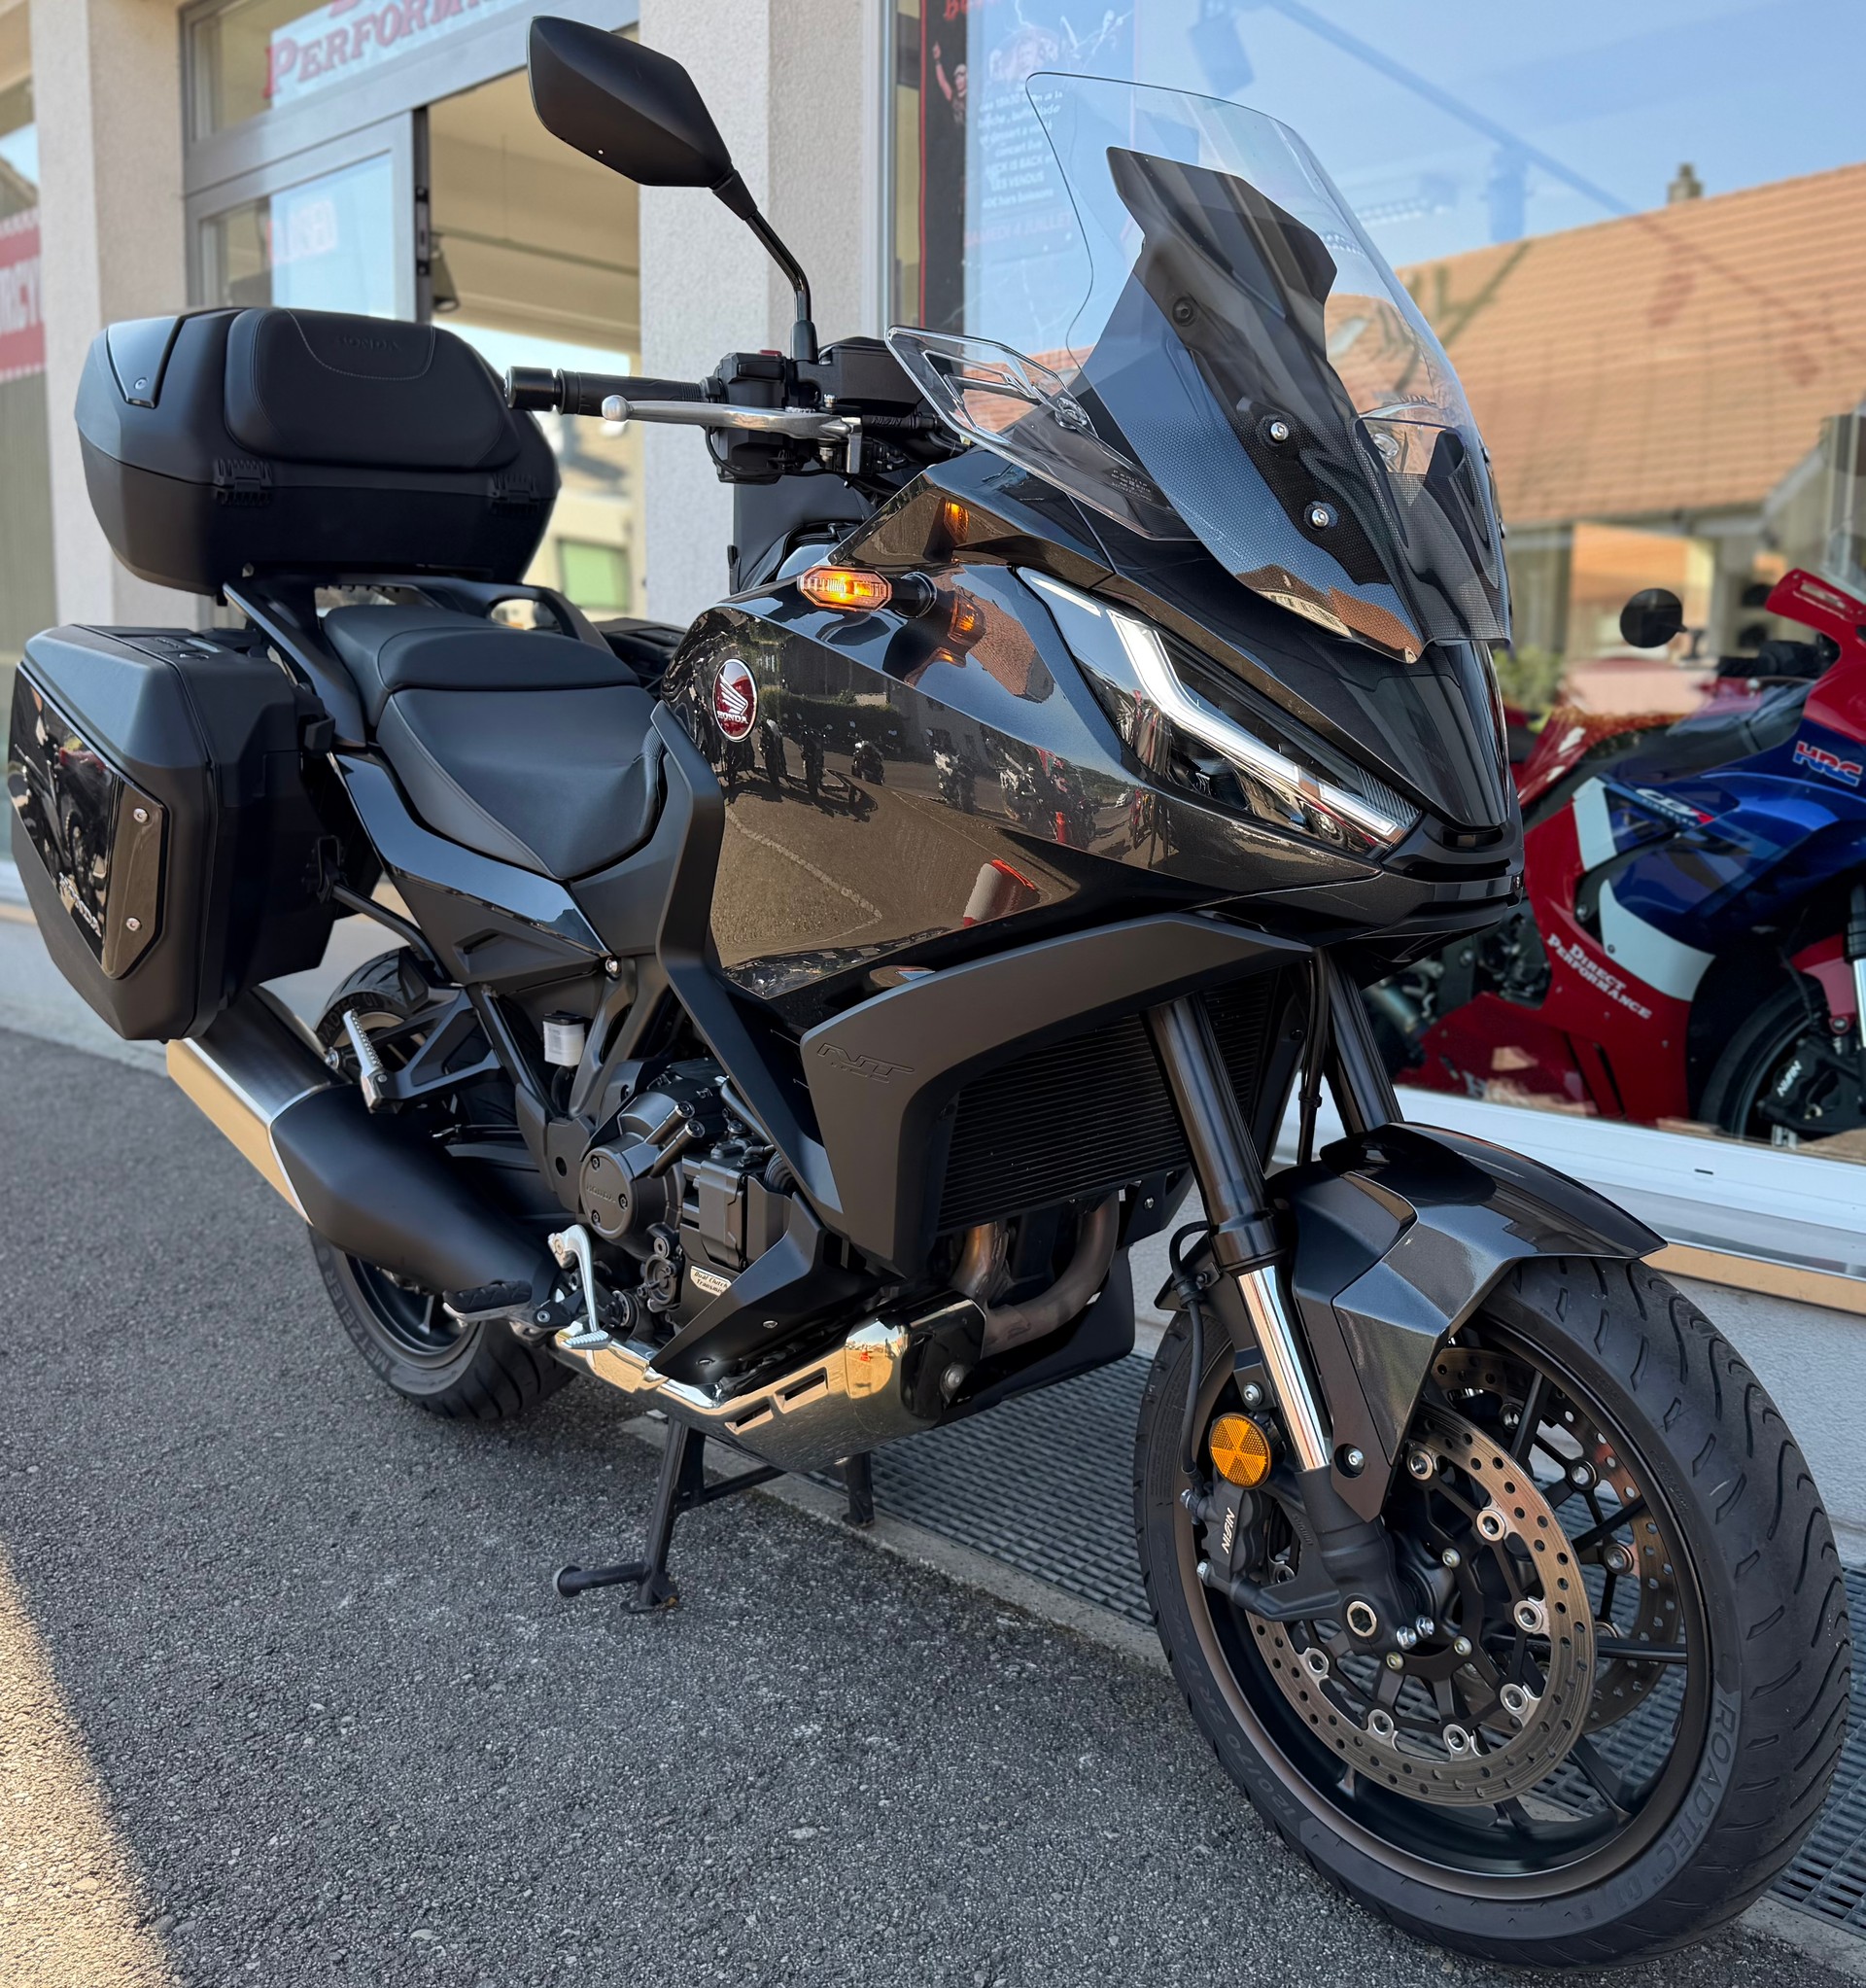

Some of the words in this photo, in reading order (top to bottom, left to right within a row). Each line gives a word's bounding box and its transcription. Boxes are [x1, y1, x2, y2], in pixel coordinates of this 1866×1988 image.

[716, 710, 749, 725] HONDA
[1793, 740, 1863, 788] HRC
[1546, 932, 1652, 1020] PERFORMANCE
[1570, 943, 1627, 993] DIRECT
[586, 1184, 616, 1204] HONDA
[694, 1271, 708, 1281] Dual
[708, 1277, 728, 1289] Clutch
[324, 1268, 389, 1372] METZELER
[1221, 1507, 1235, 1555] NISSIN
[1226, 1732, 1296, 1819] 120/70
[1656, 1699, 1737, 1876] ROADTEC
